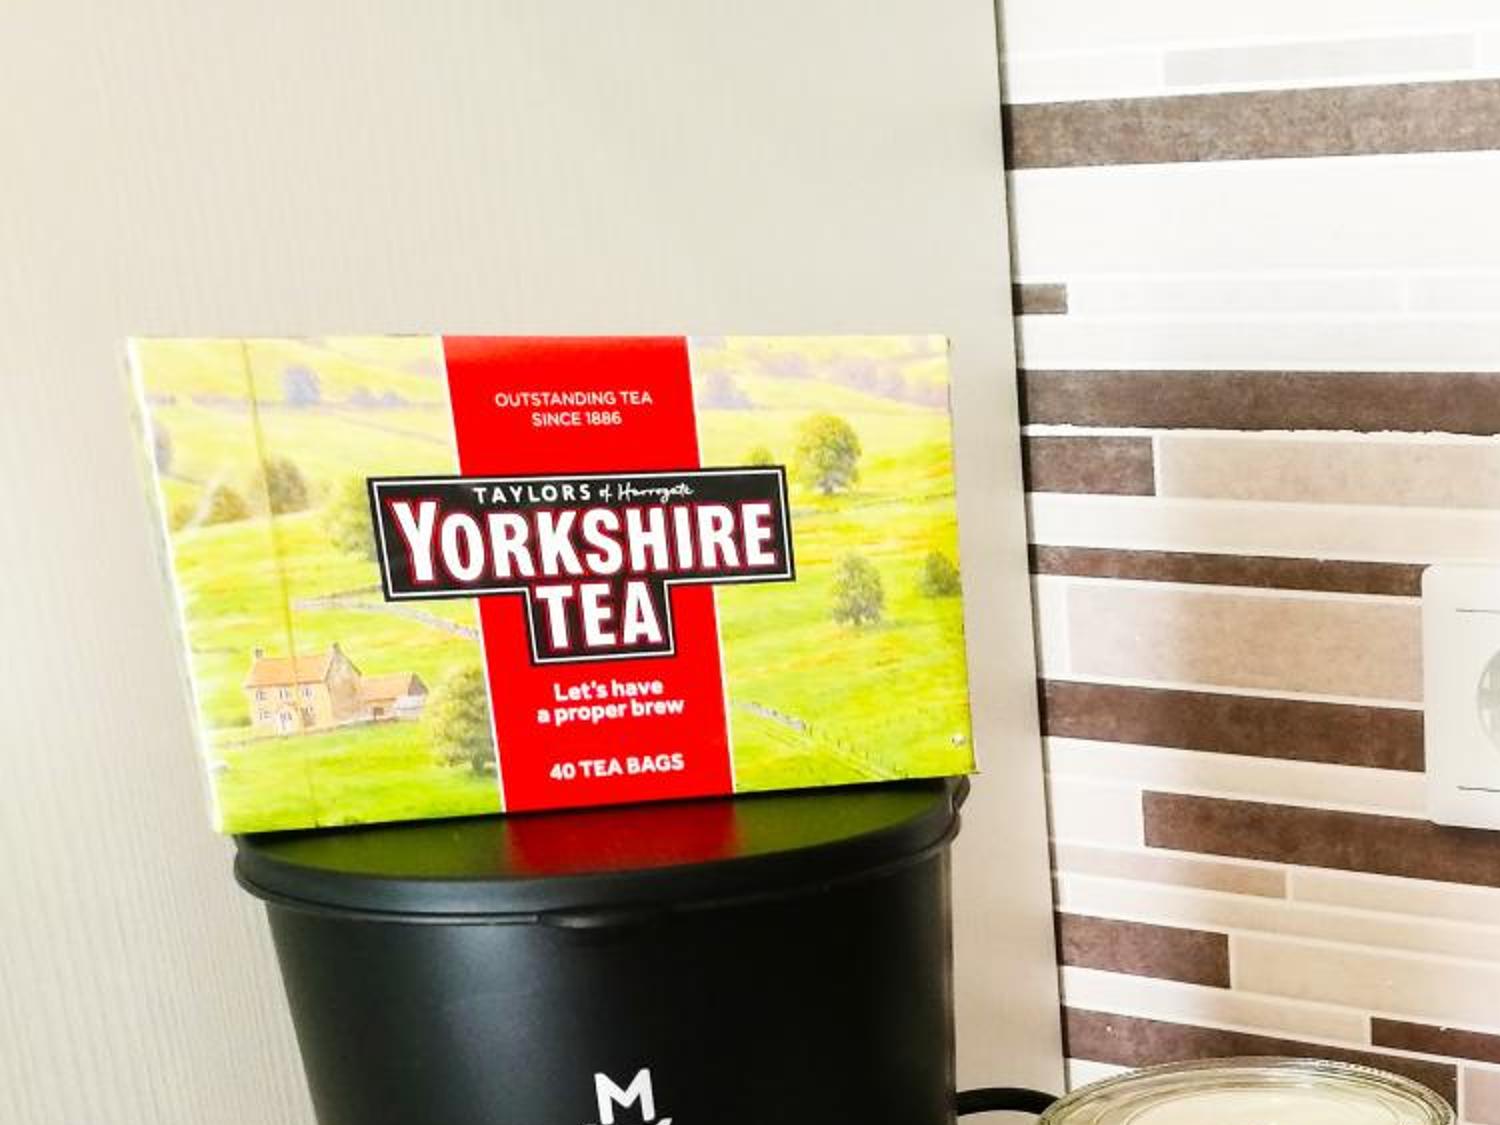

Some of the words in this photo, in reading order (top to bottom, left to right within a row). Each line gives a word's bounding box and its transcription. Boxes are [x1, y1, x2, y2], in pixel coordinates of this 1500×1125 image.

[495, 392, 617, 408] OUTSTANDING
[620, 391, 653, 405] TEA
[531, 413, 582, 427] SINCE
[585, 411, 622, 425] 1886
[473, 484, 591, 504] TAYLORS
[599, 487, 613, 503] of
[617, 482, 695, 503] Harrogate
[391, 500, 777, 583] YORKSHIRE
[535, 581, 664, 650] TEA
[553, 680, 608, 702] Let's
[610, 679, 664, 697] have
[537, 708, 550, 724] a
[554, 702, 626, 727] proper
[630, 698, 685, 717] brew
[549, 763, 576, 780] 40
[578, 757, 623, 777] TEA
[626, 752, 685, 774] BAGS
